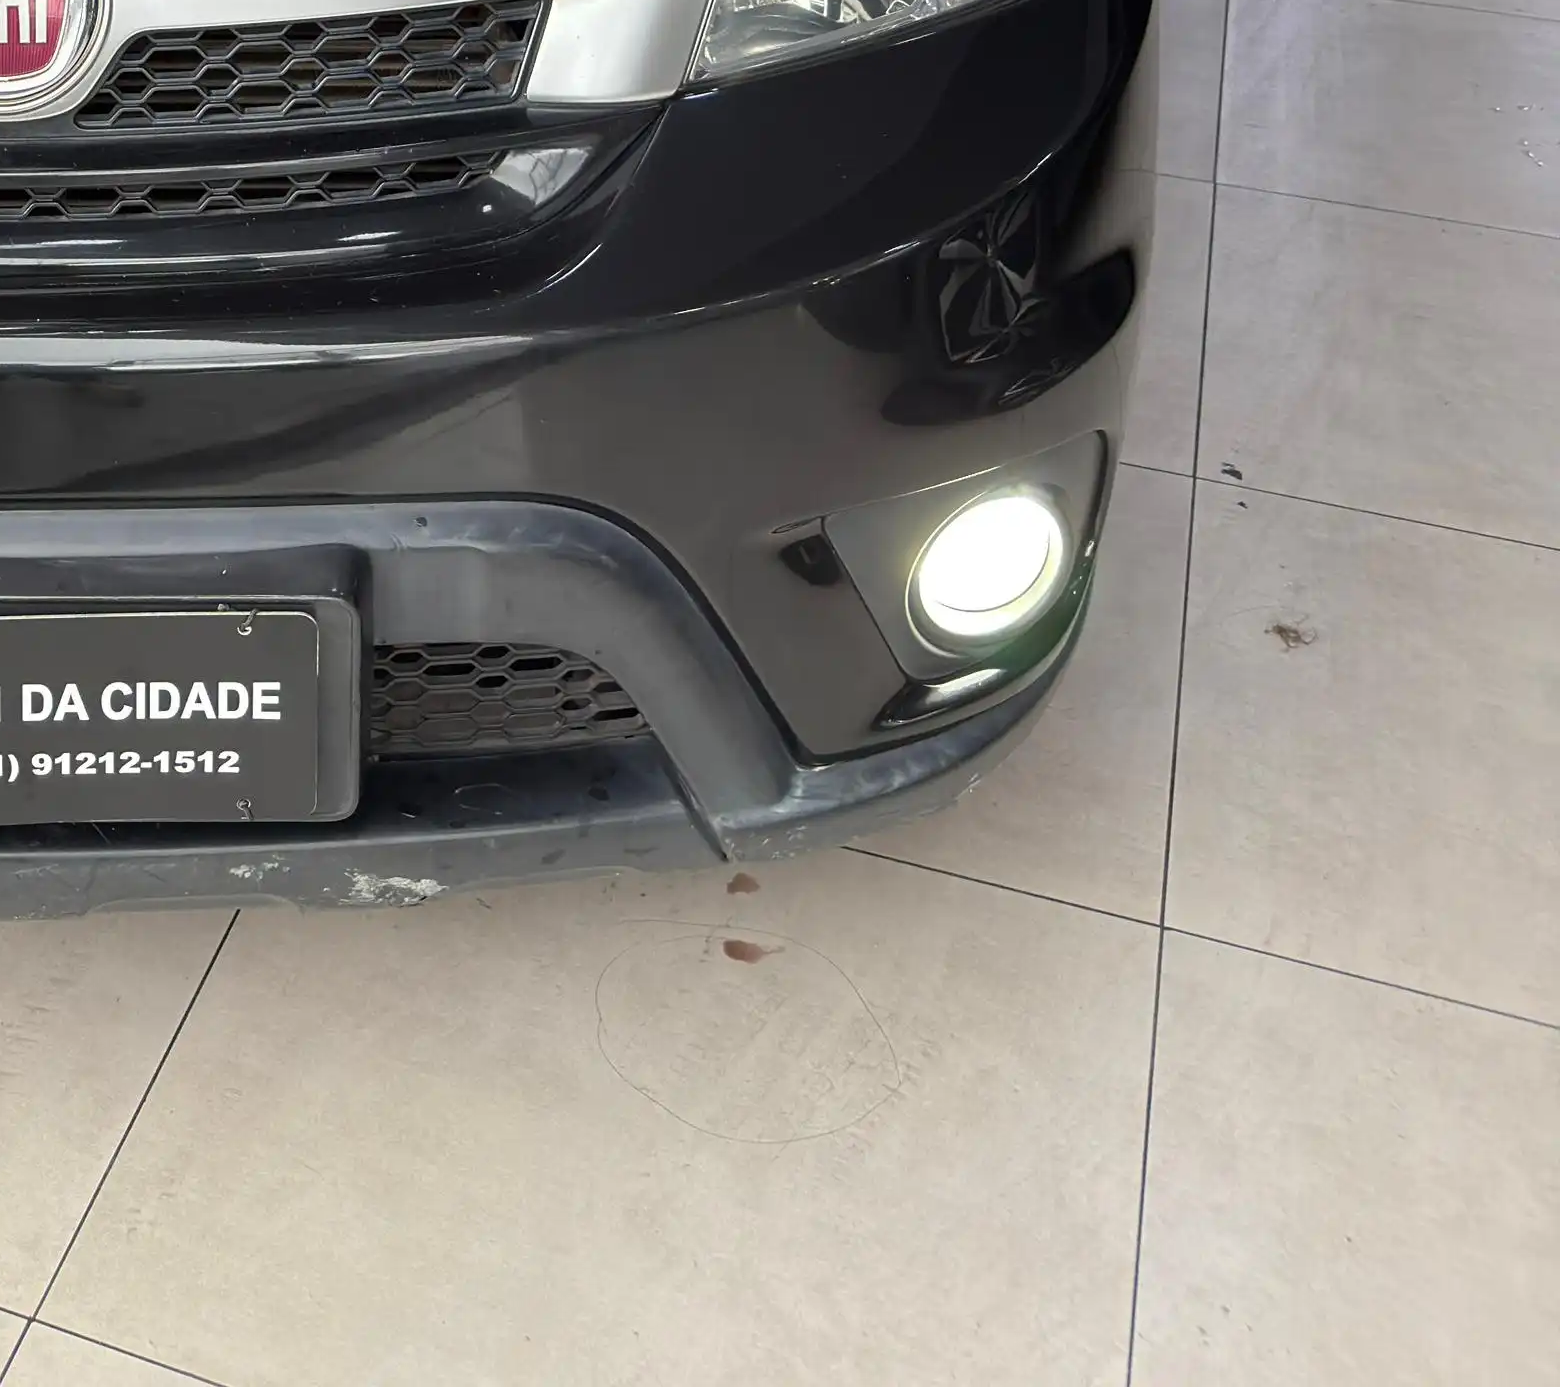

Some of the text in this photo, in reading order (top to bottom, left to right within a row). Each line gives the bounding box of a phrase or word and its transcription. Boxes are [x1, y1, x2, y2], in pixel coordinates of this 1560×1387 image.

[21, 683, 90, 723] DA
[100, 681, 282, 720] CIDADE
[30, 749, 241, 776] 91212-1512
